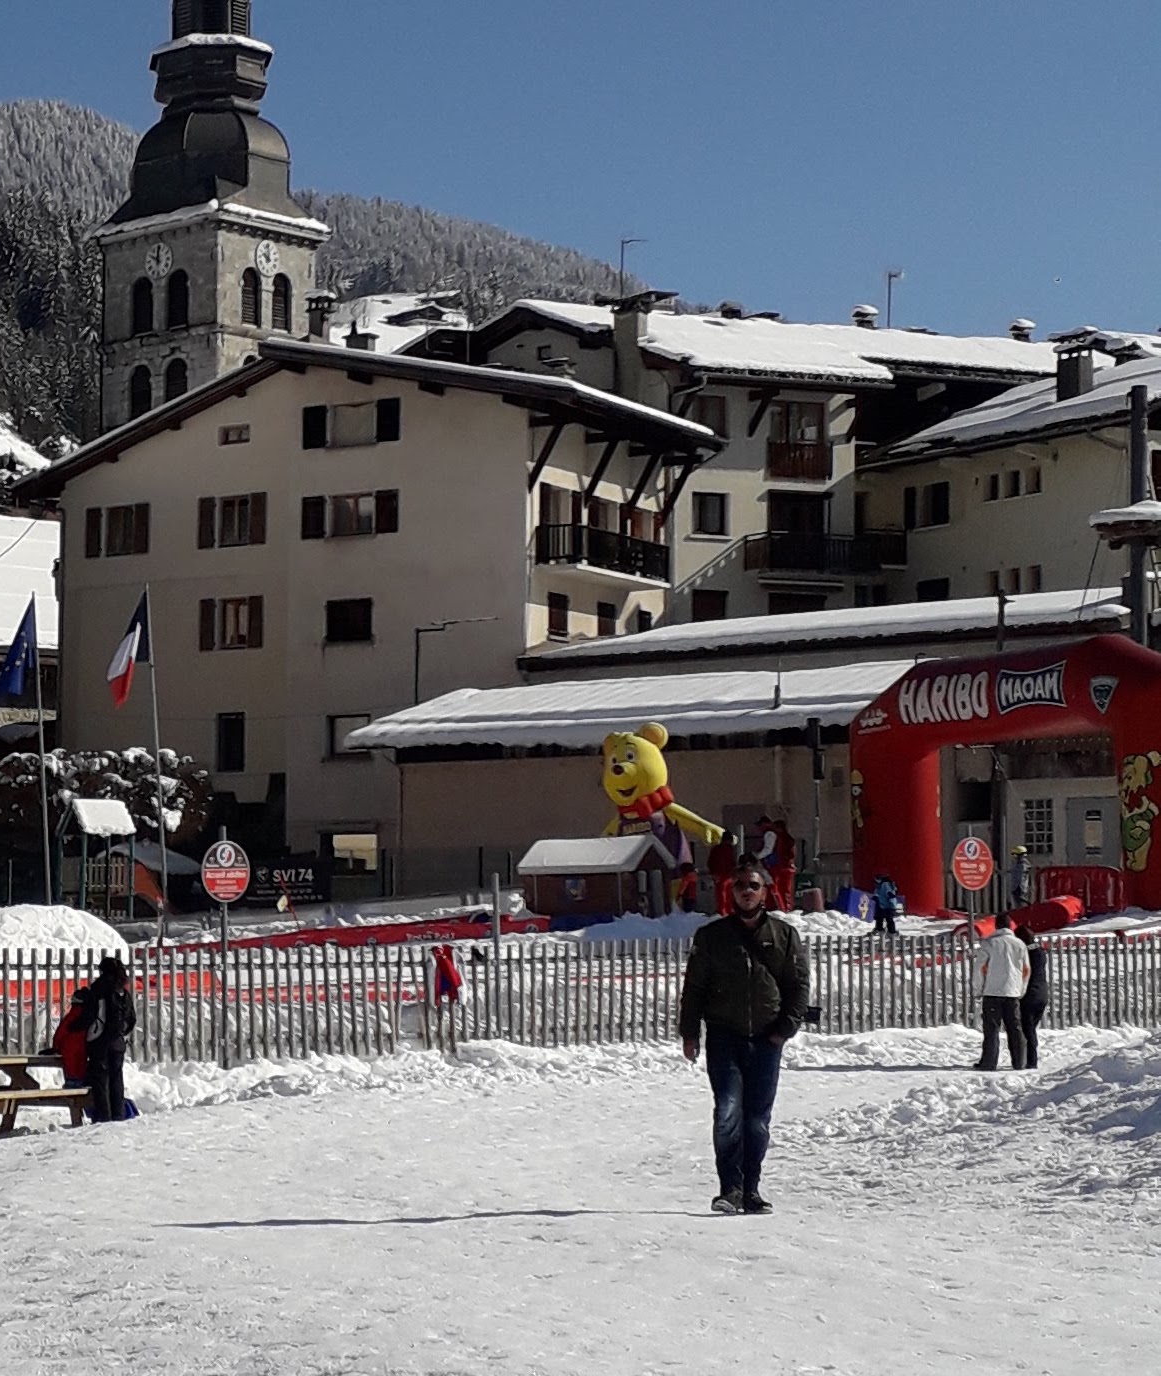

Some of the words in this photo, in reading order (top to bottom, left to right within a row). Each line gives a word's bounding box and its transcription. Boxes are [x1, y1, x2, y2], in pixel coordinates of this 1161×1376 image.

[898, 671, 989, 724] HARIBO
[1000, 671, 1059, 707] MAOAM
[298, 868, 314, 881] 74
